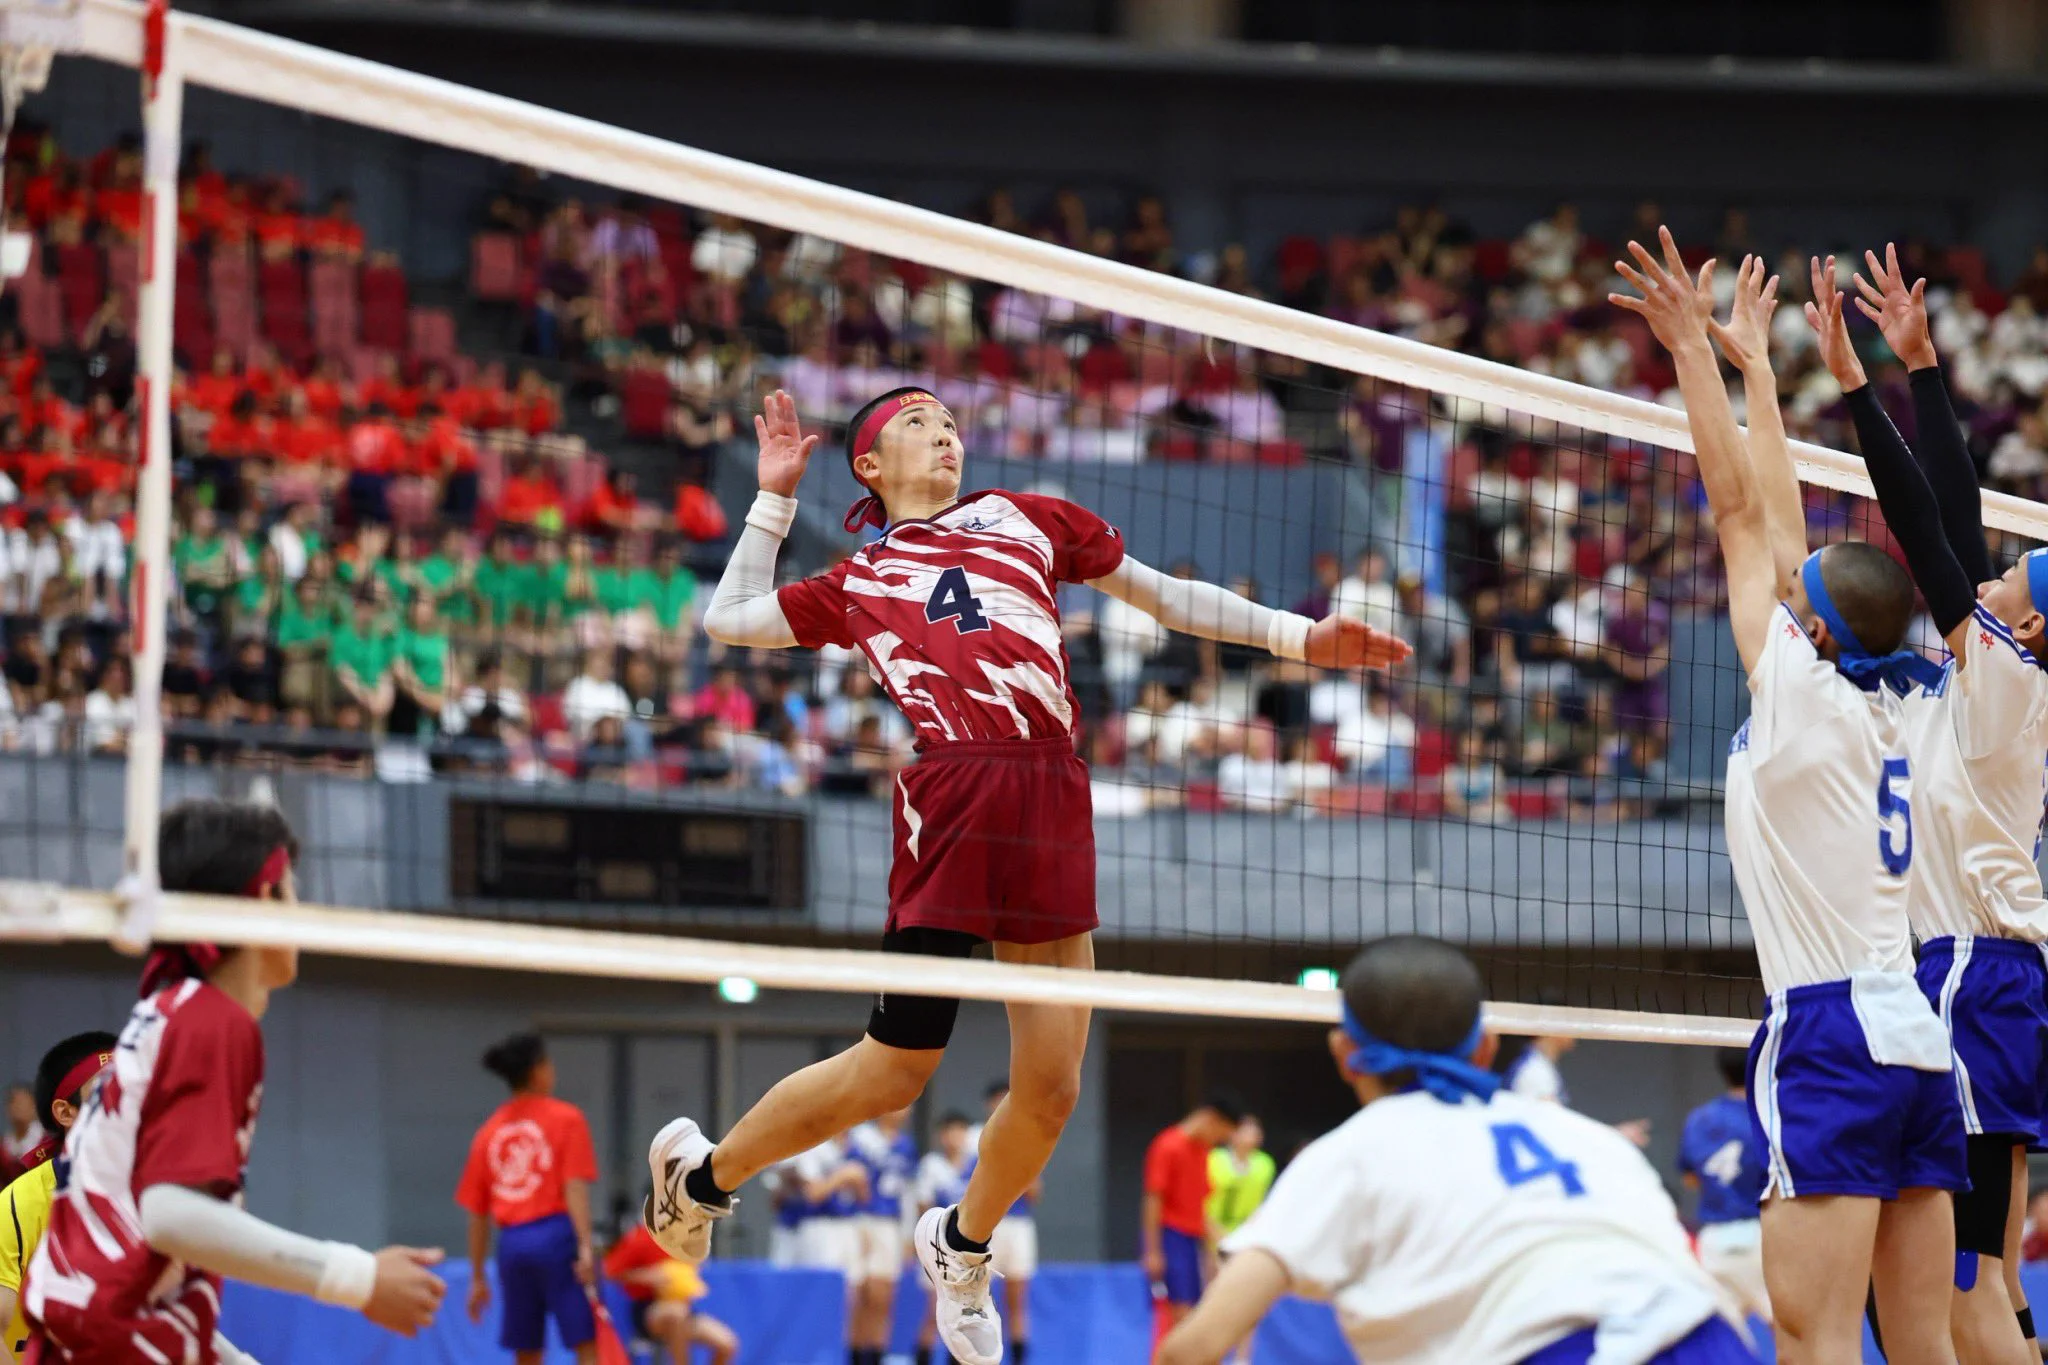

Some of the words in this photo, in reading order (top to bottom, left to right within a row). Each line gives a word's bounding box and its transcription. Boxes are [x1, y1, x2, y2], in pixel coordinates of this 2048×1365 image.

[924, 565, 992, 635] 4
[1877, 757, 1912, 877] 5
[1491, 1123, 1586, 1197] 4
[1703, 1139, 1743, 1188] 4
